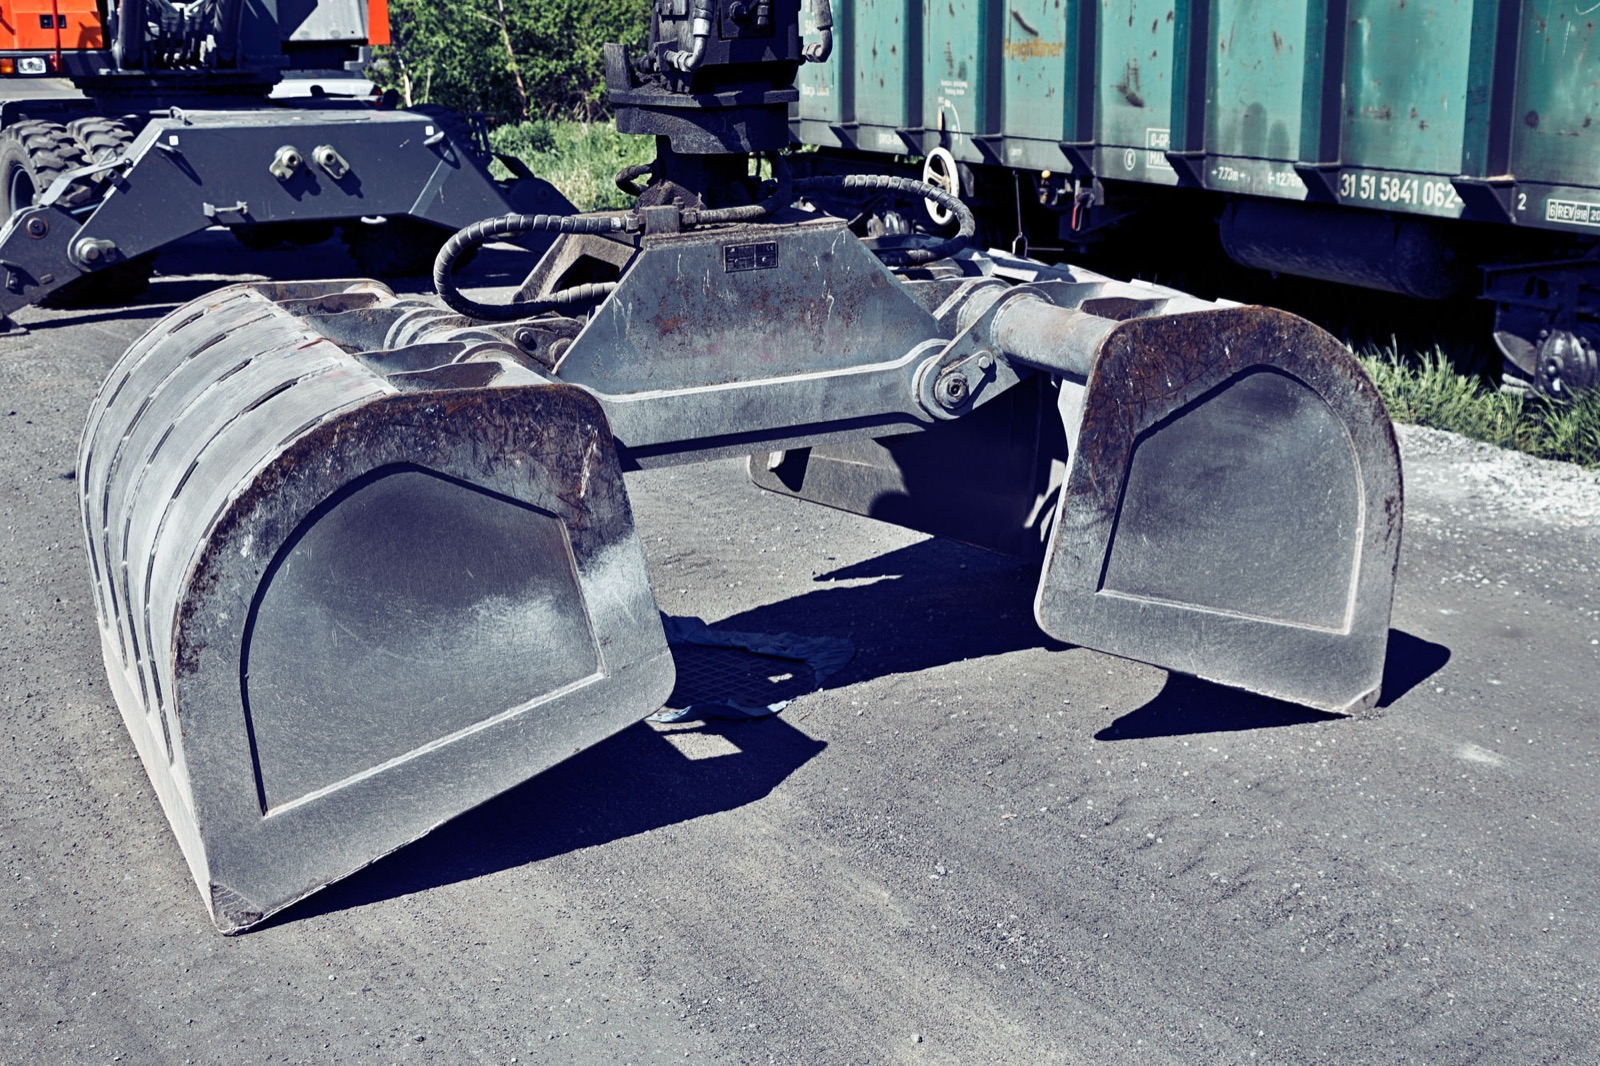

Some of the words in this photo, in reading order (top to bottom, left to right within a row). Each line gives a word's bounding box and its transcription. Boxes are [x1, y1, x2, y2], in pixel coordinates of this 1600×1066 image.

[1340, 173, 1356, 198] 31
[1359, 174, 1376, 200] 51
[1379, 176, 1419, 205] 5841
[1517, 193, 1527, 211] 2
[1557, 205, 1575, 219] REV
